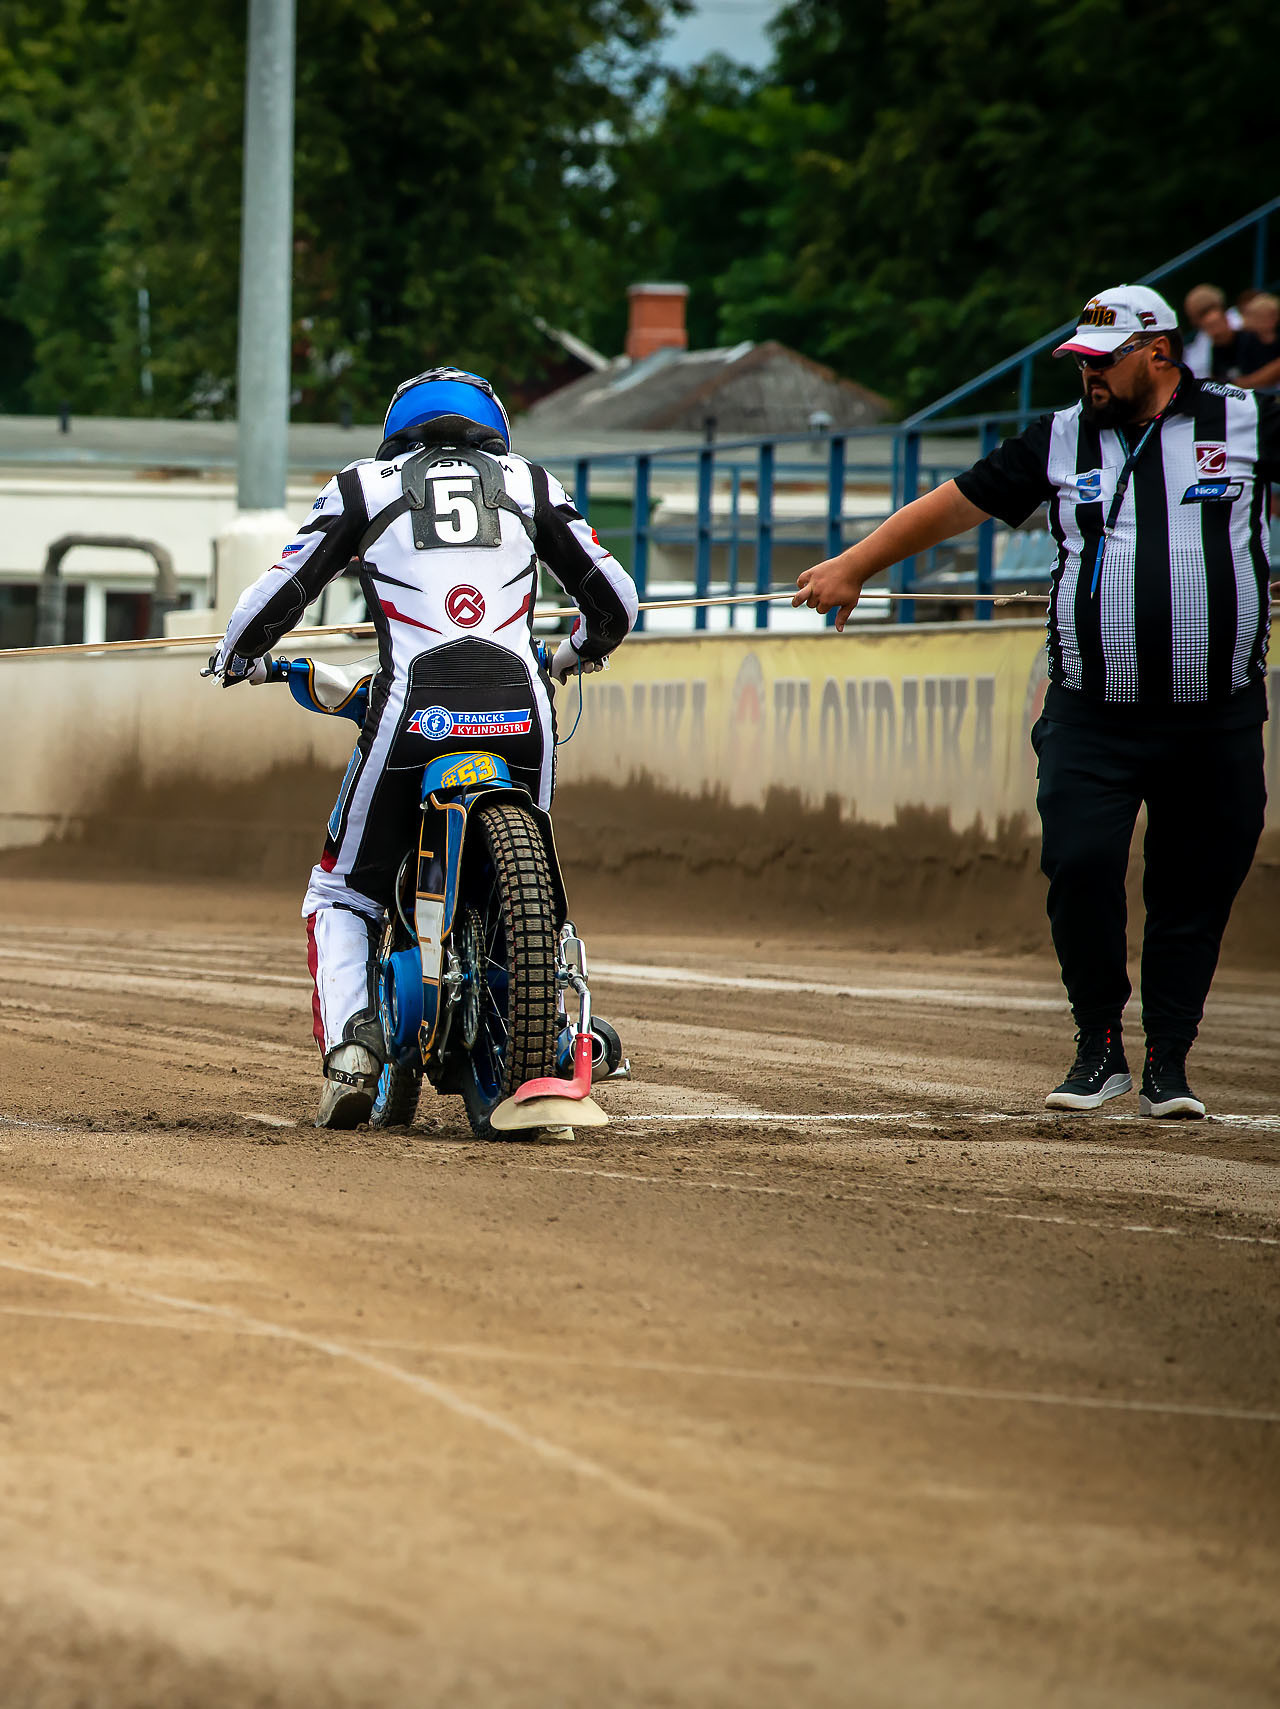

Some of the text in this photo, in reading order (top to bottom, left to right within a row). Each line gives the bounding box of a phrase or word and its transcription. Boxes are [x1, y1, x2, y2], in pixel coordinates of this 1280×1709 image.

[1194, 487, 1219, 496] Nice
[433, 479, 479, 544] 5
[458, 714, 505, 724] FRANCKS
[457, 724, 524, 735] KYLINDUSTRI
[444, 756, 494, 788] #53
